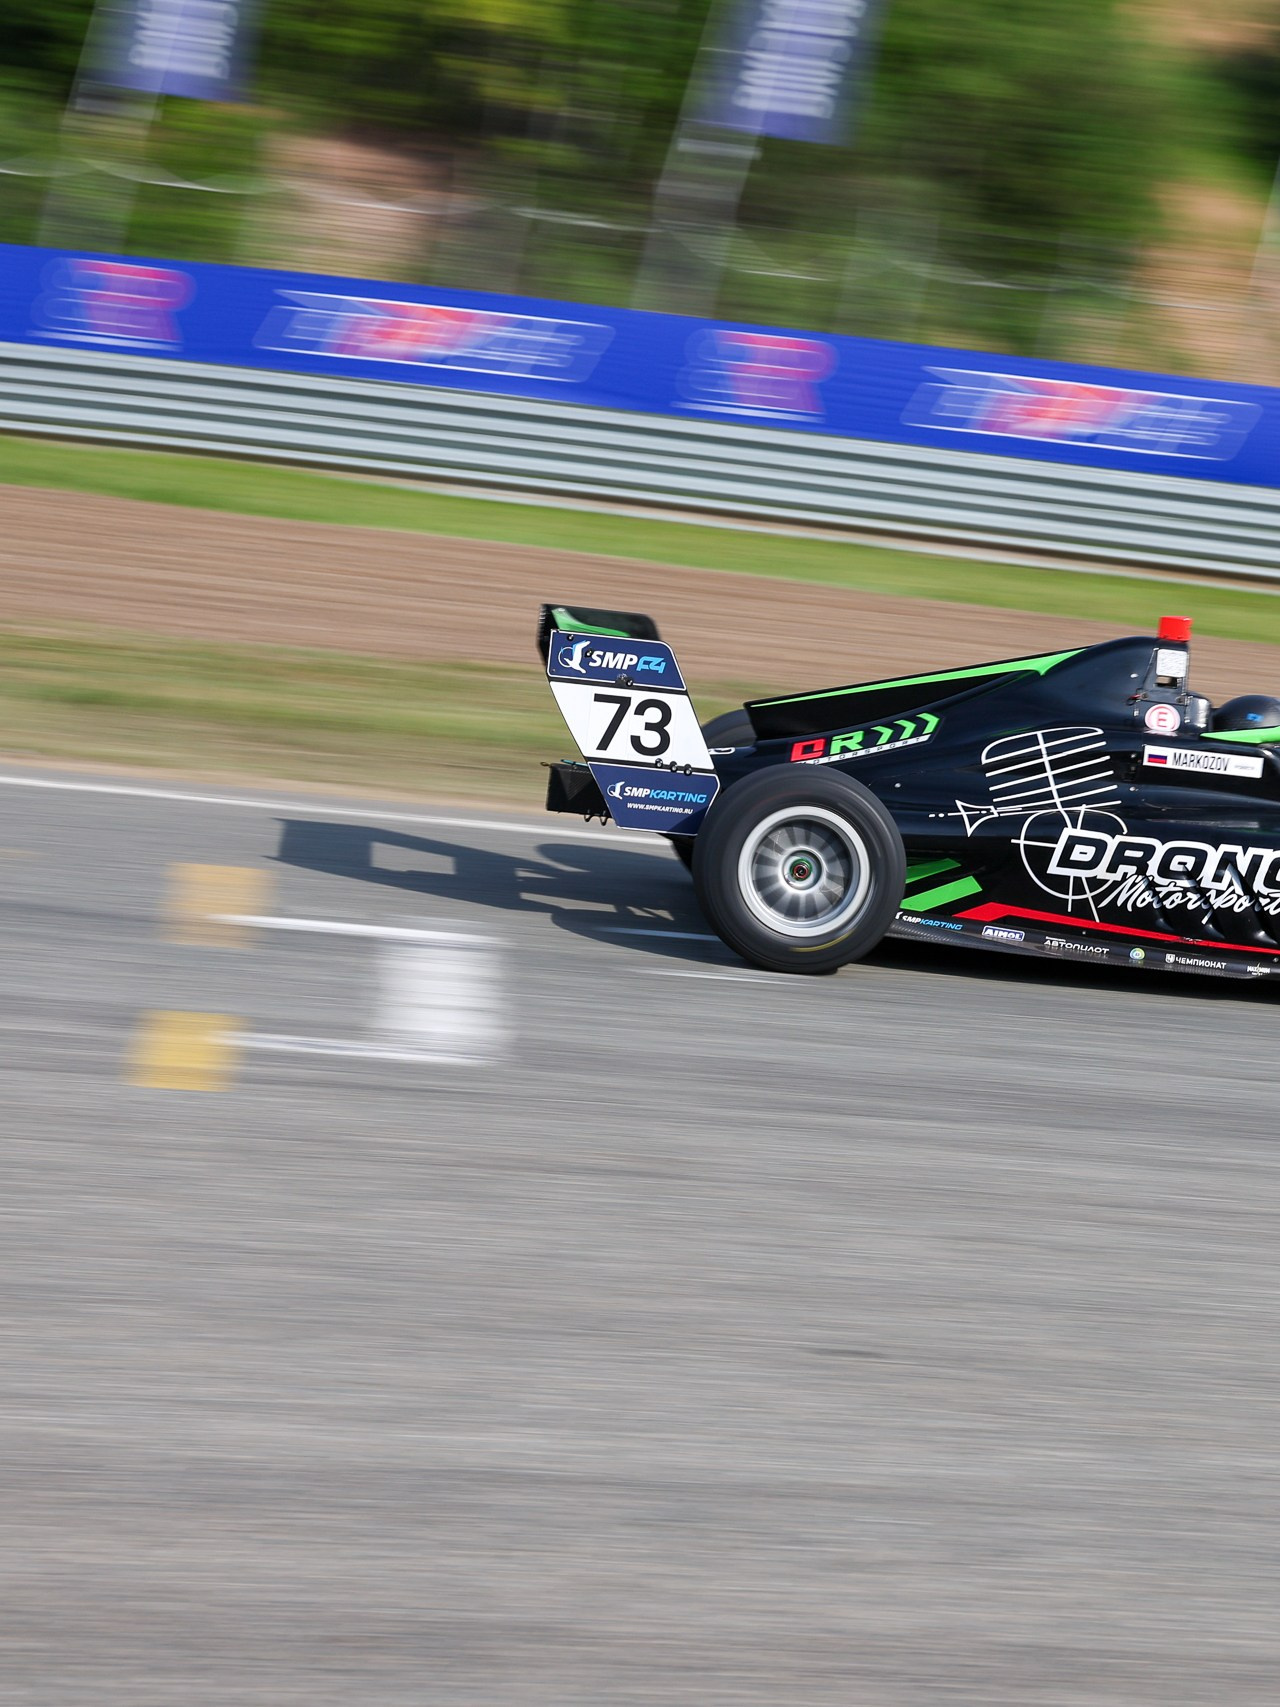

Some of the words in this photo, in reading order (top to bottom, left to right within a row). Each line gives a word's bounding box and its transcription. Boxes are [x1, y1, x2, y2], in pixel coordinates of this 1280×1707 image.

[593, 692, 673, 757] 73
[1171, 751, 1231, 772] MARKOZOV
[984, 928, 1023, 940] AIMOL
[1175, 957, 1227, 970] ЧЕМПИОНАТ
